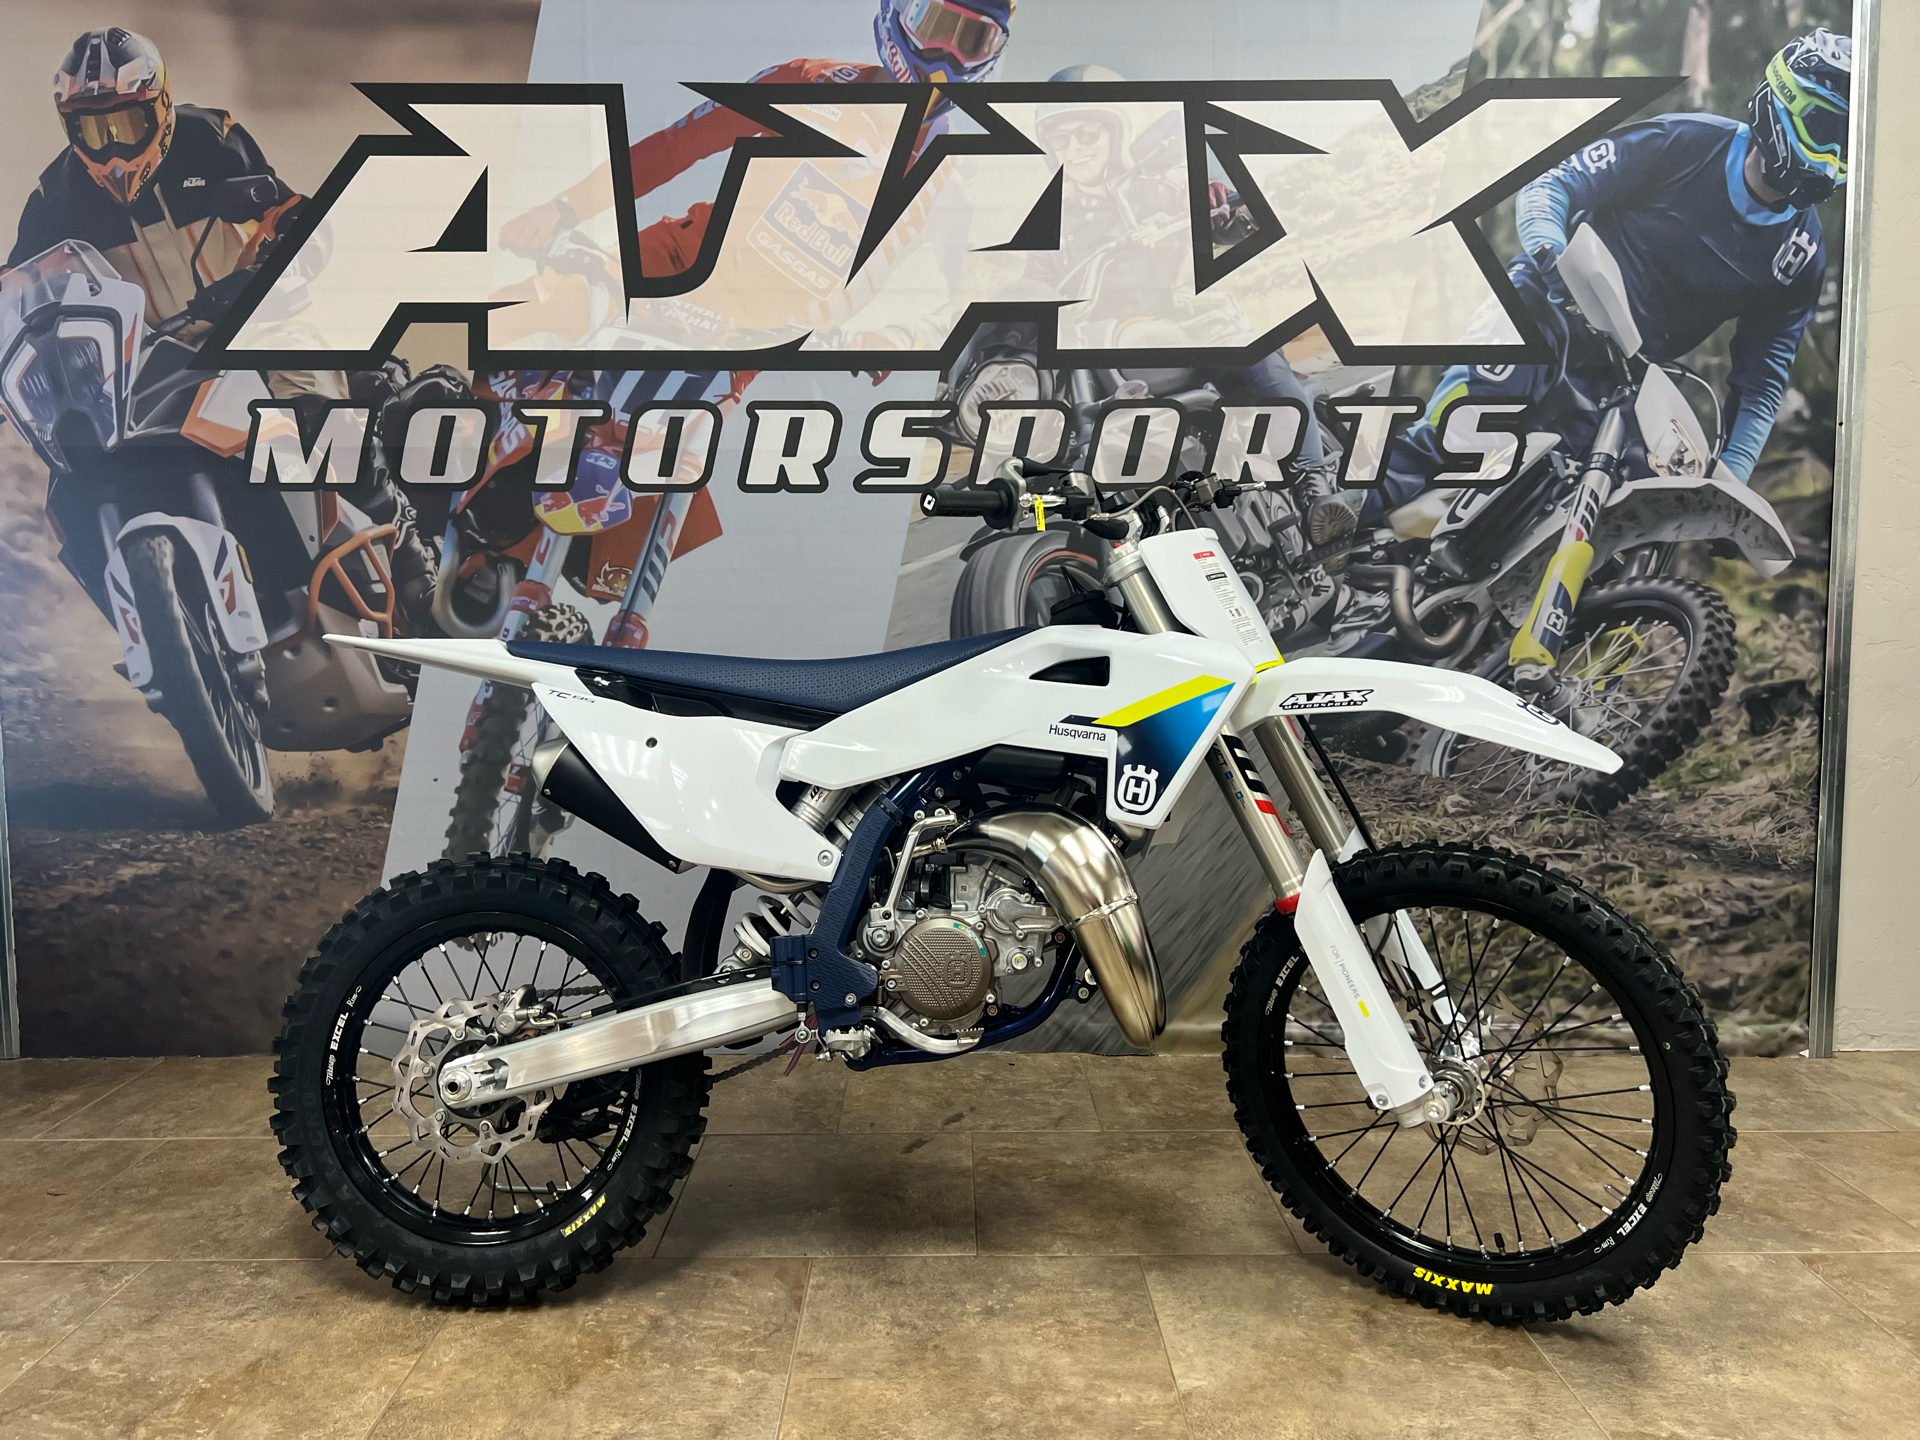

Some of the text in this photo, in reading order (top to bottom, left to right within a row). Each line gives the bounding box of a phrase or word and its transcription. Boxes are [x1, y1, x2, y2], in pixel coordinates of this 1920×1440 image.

[190, 82, 1688, 369] AJAX
[756, 231, 831, 290] GASGAS
[248, 400, 1530, 493] MOTORSPORTS
[549, 689, 571, 699] TC
[1279, 689, 1374, 707] AJAX
[1048, 724, 1107, 742] Husqvarna
[1275, 955, 1300, 988] EXCEL
[1330, 944, 1361, 1000] FOR PIONEERS
[330, 1011, 350, 1051] EXCEL
[621, 1103, 639, 1144] EXCEL
[563, 1194, 607, 1237] MAXXIS
[1616, 1202, 1648, 1236] EXCEL
[1413, 1266, 1494, 1295] MAXXIS
